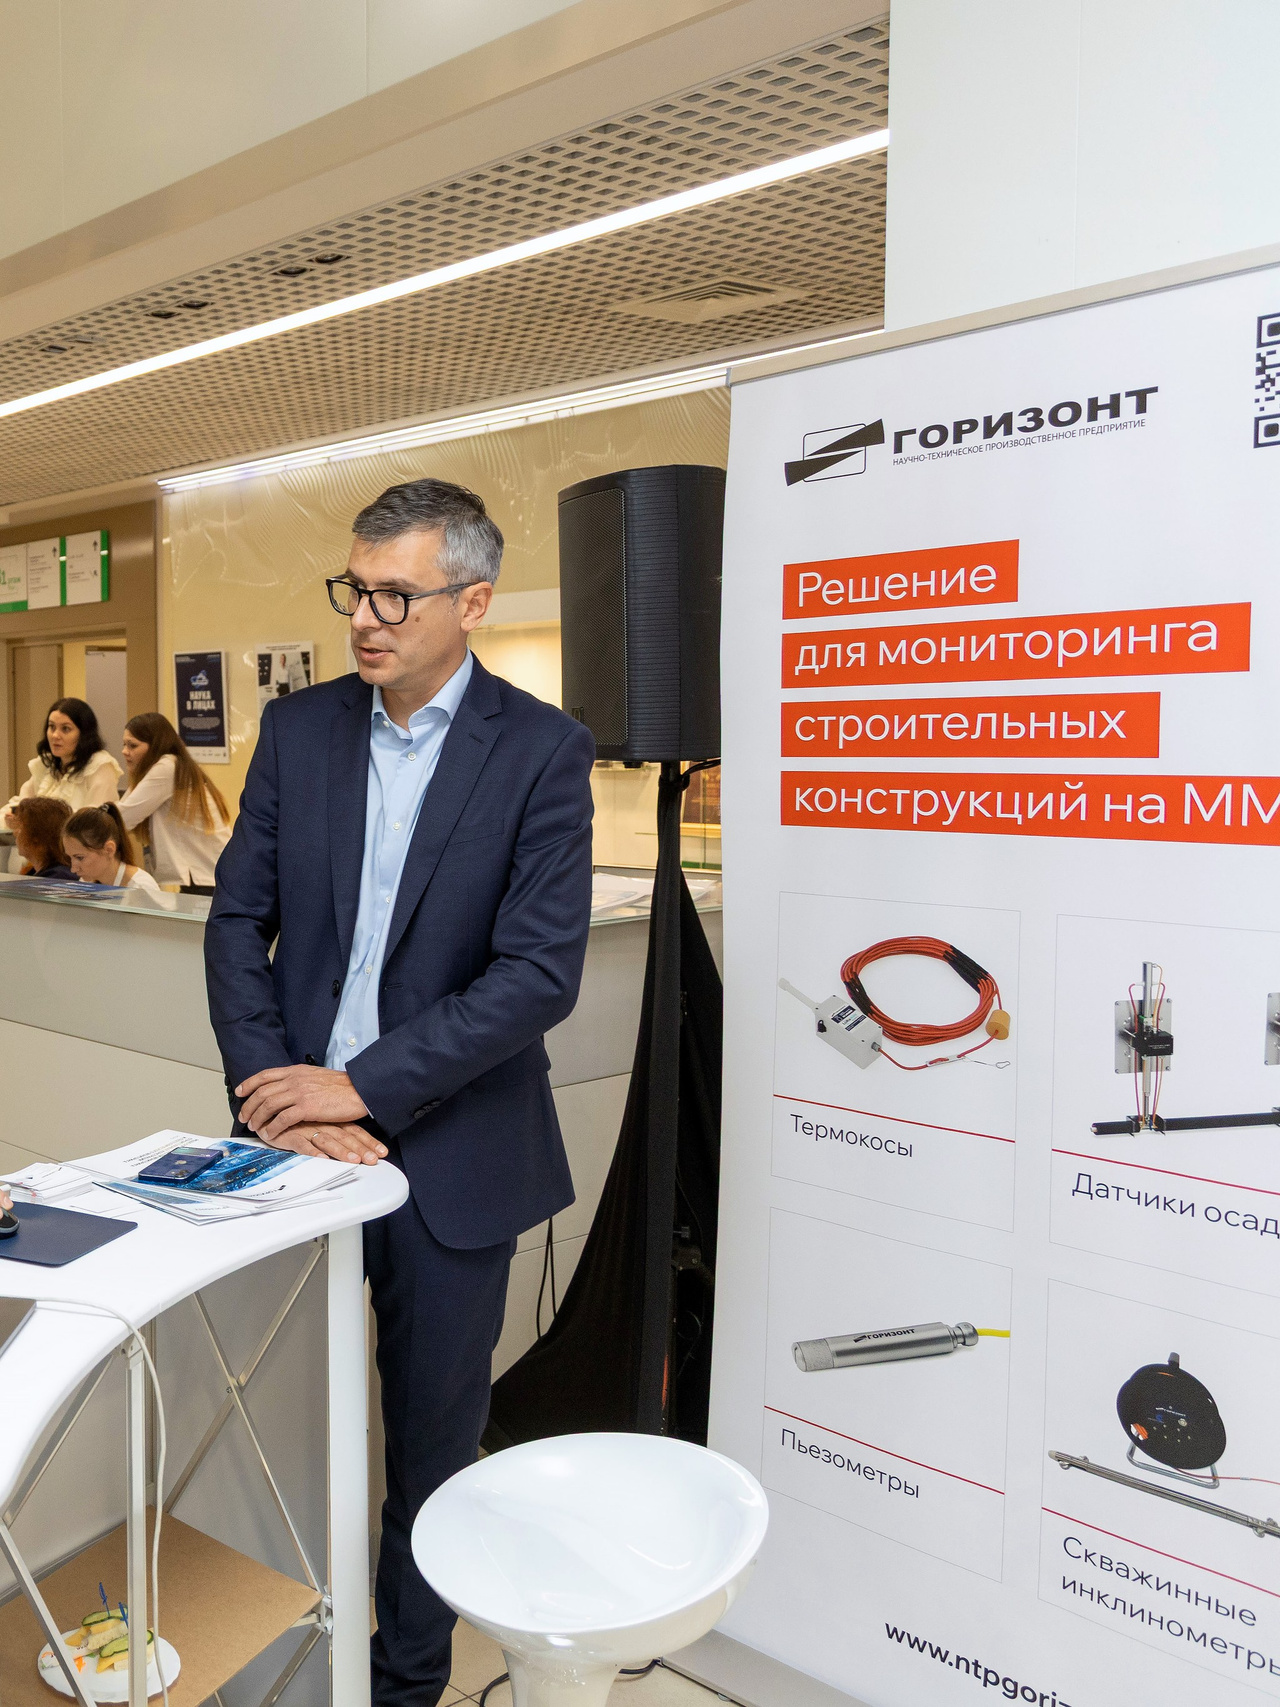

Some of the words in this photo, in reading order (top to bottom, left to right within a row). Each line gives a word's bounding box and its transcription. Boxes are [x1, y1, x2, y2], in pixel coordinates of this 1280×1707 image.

[893, 386, 1159, 454] ГОРИЗОНТ
[893, 444, 983, 466] НАУЧНО-ТЕХНИЧЕСКОЕ
[985, 430, 1077, 451] ПРОИЗВОДСТВЕННОЕ
[1078, 418, 1146, 438] ПРЕДПРИЯТИЕ
[797, 562, 997, 608] Решение
[794, 639, 866, 676] для
[878, 619, 1219, 667] мониторинга
[189, 690, 212, 701] НАУКА
[794, 708, 1127, 750] строительных
[795, 781, 1087, 826] конструкций
[1104, 792, 1166, 825] на
[790, 1113, 914, 1158] Термокосы
[1072, 1172, 1195, 1218] Датчики
[1204, 1206, 1280, 1240] осад
[867, 1328, 916, 1340] ГОРИЗОНТ
[780, 1428, 921, 1499] Пьезометры
[1063, 1536, 1257, 1626] Скважинные
[885, 1622, 1072, 1707] www.ntpgori
